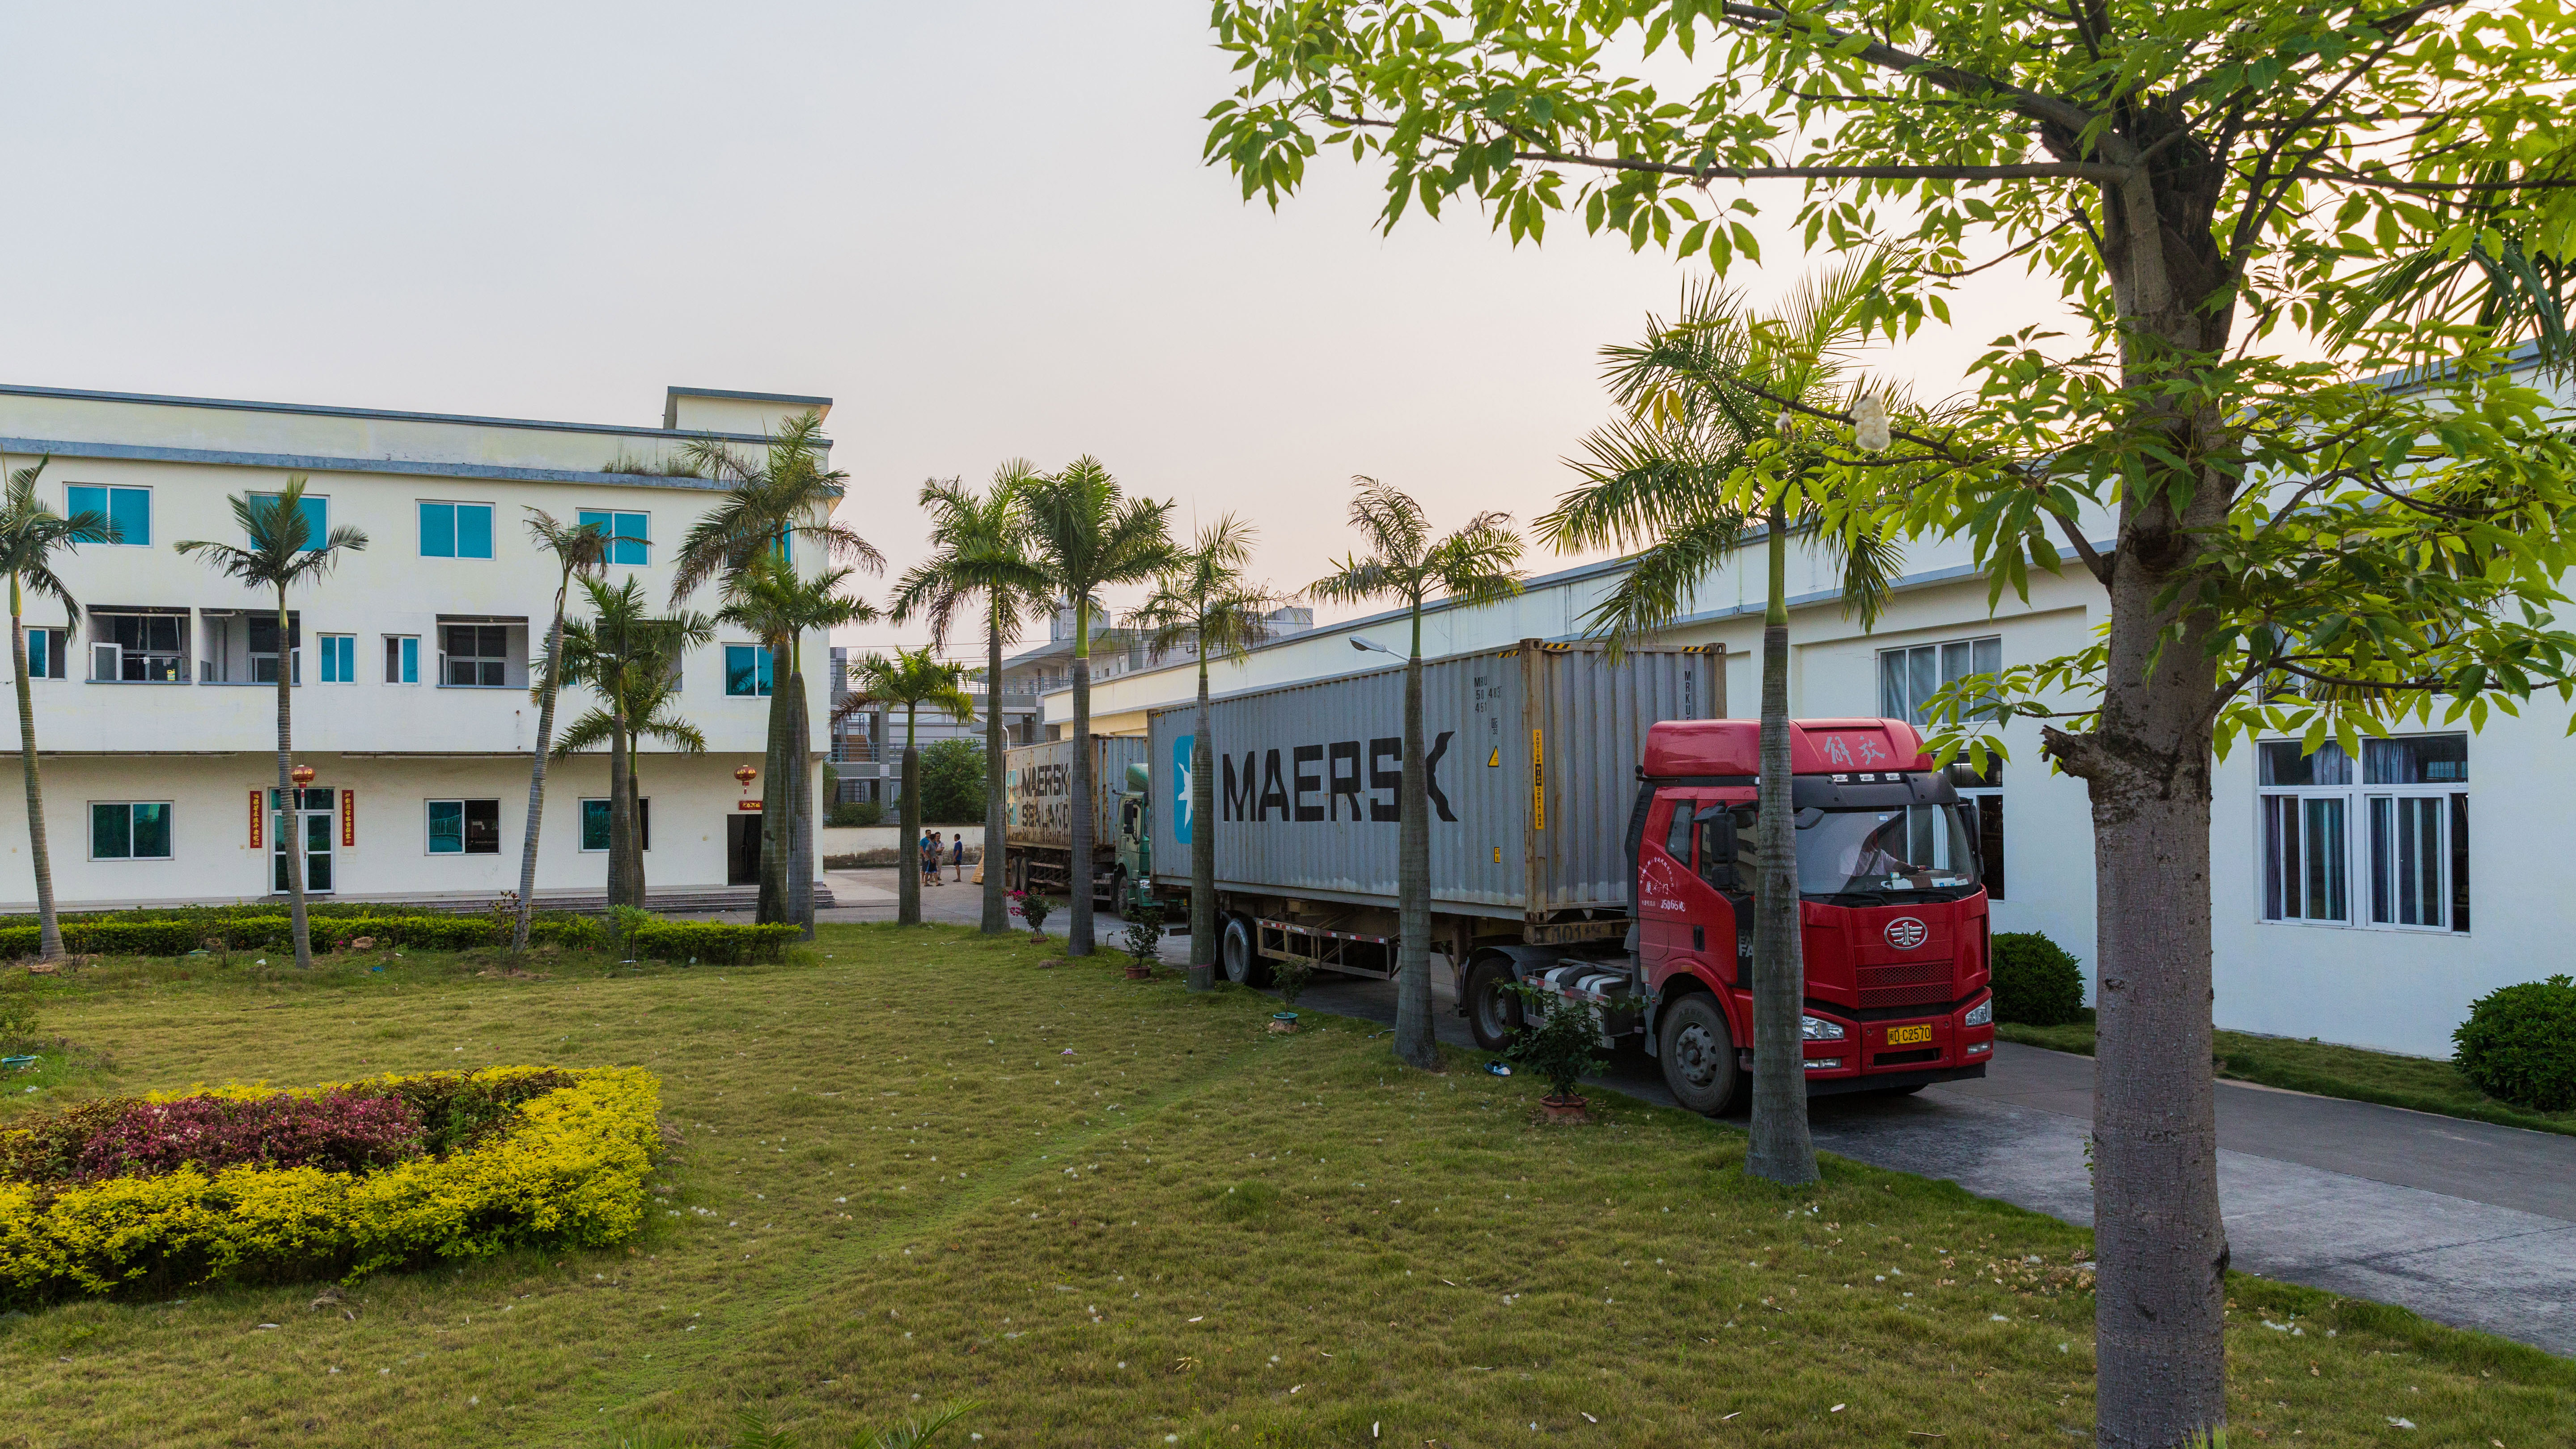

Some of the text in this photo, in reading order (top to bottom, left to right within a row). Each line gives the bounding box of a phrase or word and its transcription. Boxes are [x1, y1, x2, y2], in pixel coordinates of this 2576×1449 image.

[1475, 702, 1487, 713] 451
[1022, 763, 1069, 797] MAERSK
[1223, 731, 1458, 822] MAERSK
[1022, 804, 1069, 828] SEALAND
[1738, 944, 1754, 957] FA
